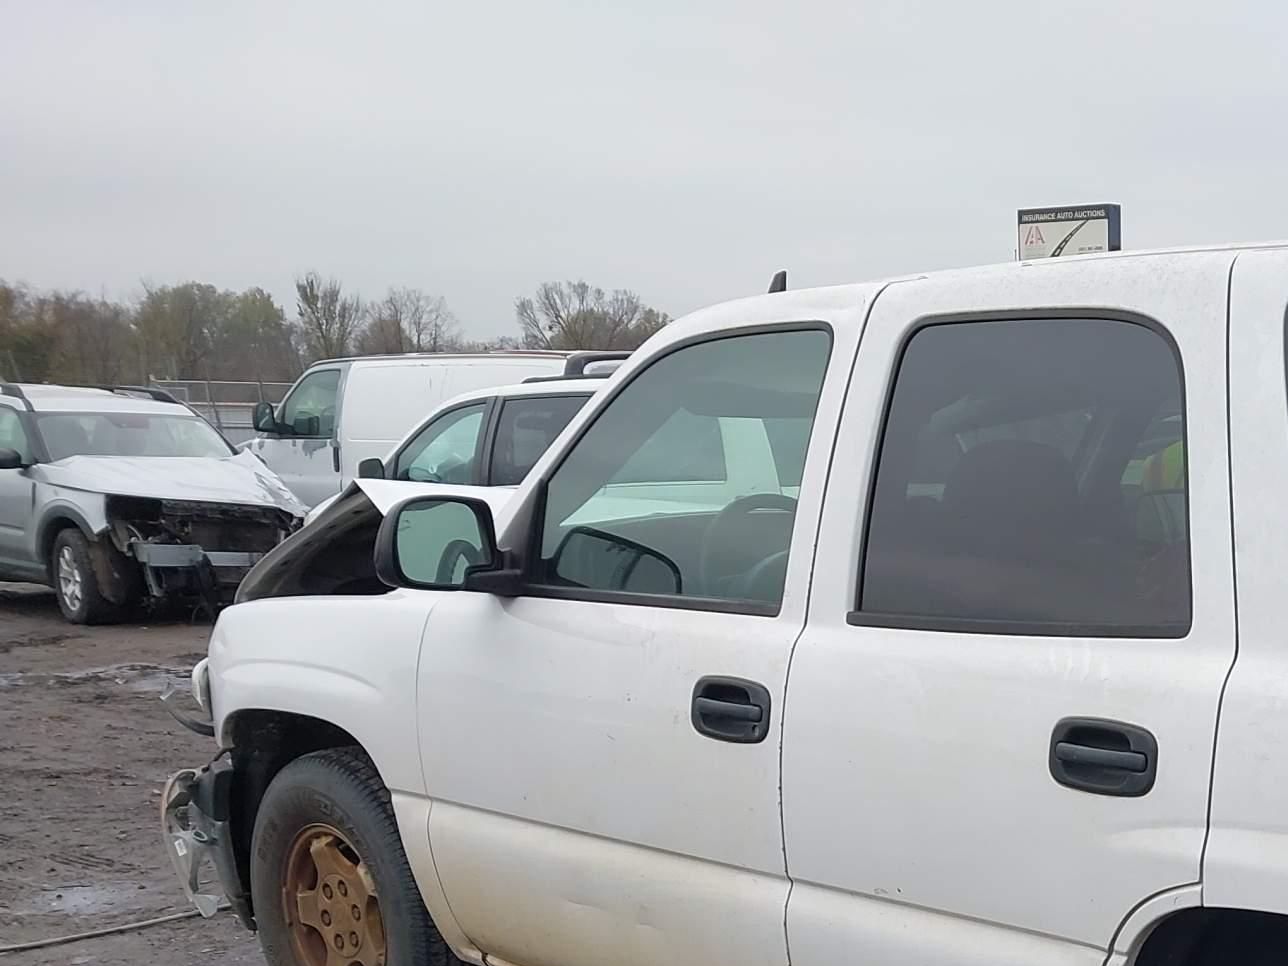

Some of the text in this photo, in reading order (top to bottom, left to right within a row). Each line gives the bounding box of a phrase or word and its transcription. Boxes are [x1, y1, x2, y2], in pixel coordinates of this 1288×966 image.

[1021, 209, 1106, 222] INSURANCE AUTO AUCTIONS
